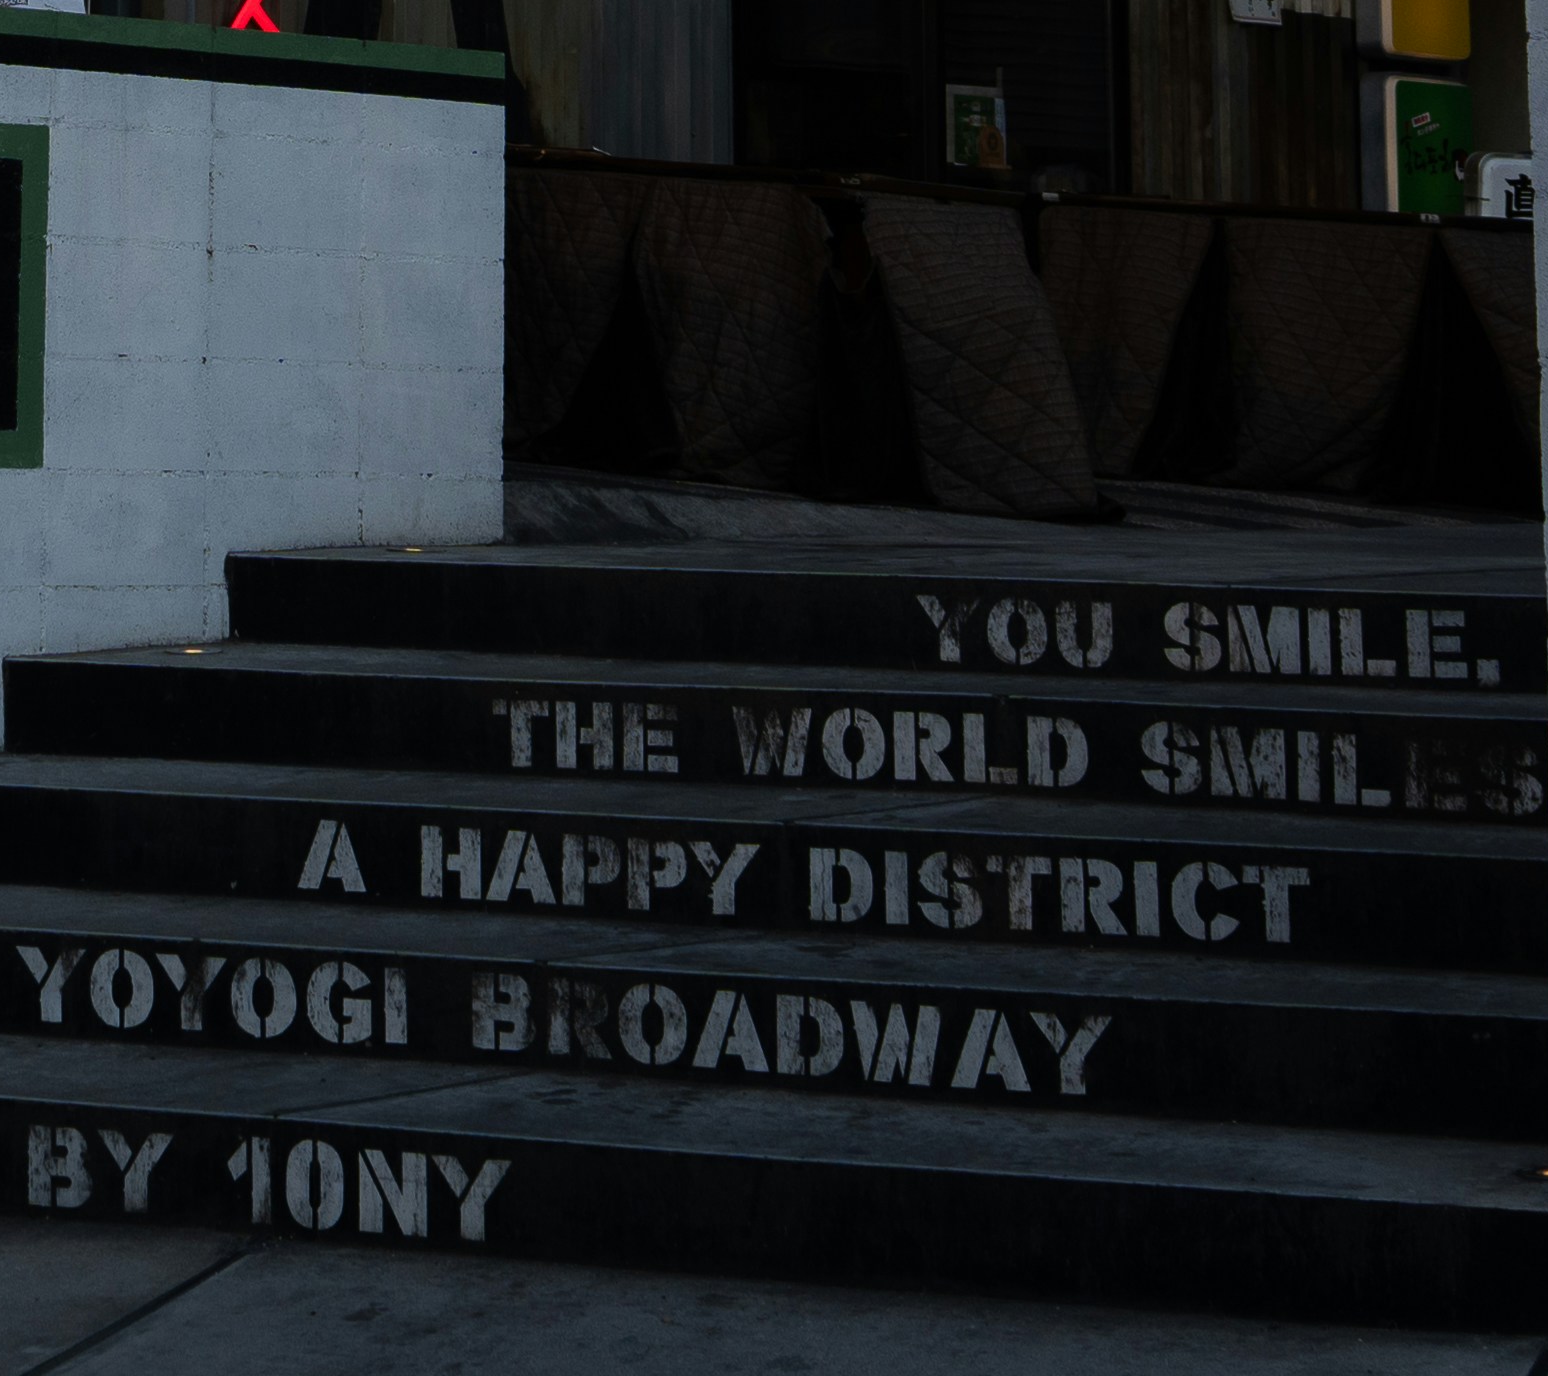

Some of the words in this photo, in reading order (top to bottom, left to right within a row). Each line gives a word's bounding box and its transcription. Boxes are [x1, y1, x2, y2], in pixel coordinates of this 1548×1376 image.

[914, 592, 1115, 672] YOU
[491, 698, 682, 777] THE
[731, 702, 1092, 791] WORLD
[295, 817, 367, 897] A
[418, 824, 763, 918] HAPPY
[807, 845, 1311, 945] DISTRICT
[16, 943, 410, 1047] YOYOGI
[470, 969, 1113, 1098] BROADWAY
[27, 1123, 173, 1212] BY
[227, 1136, 513, 1244] 10NY
